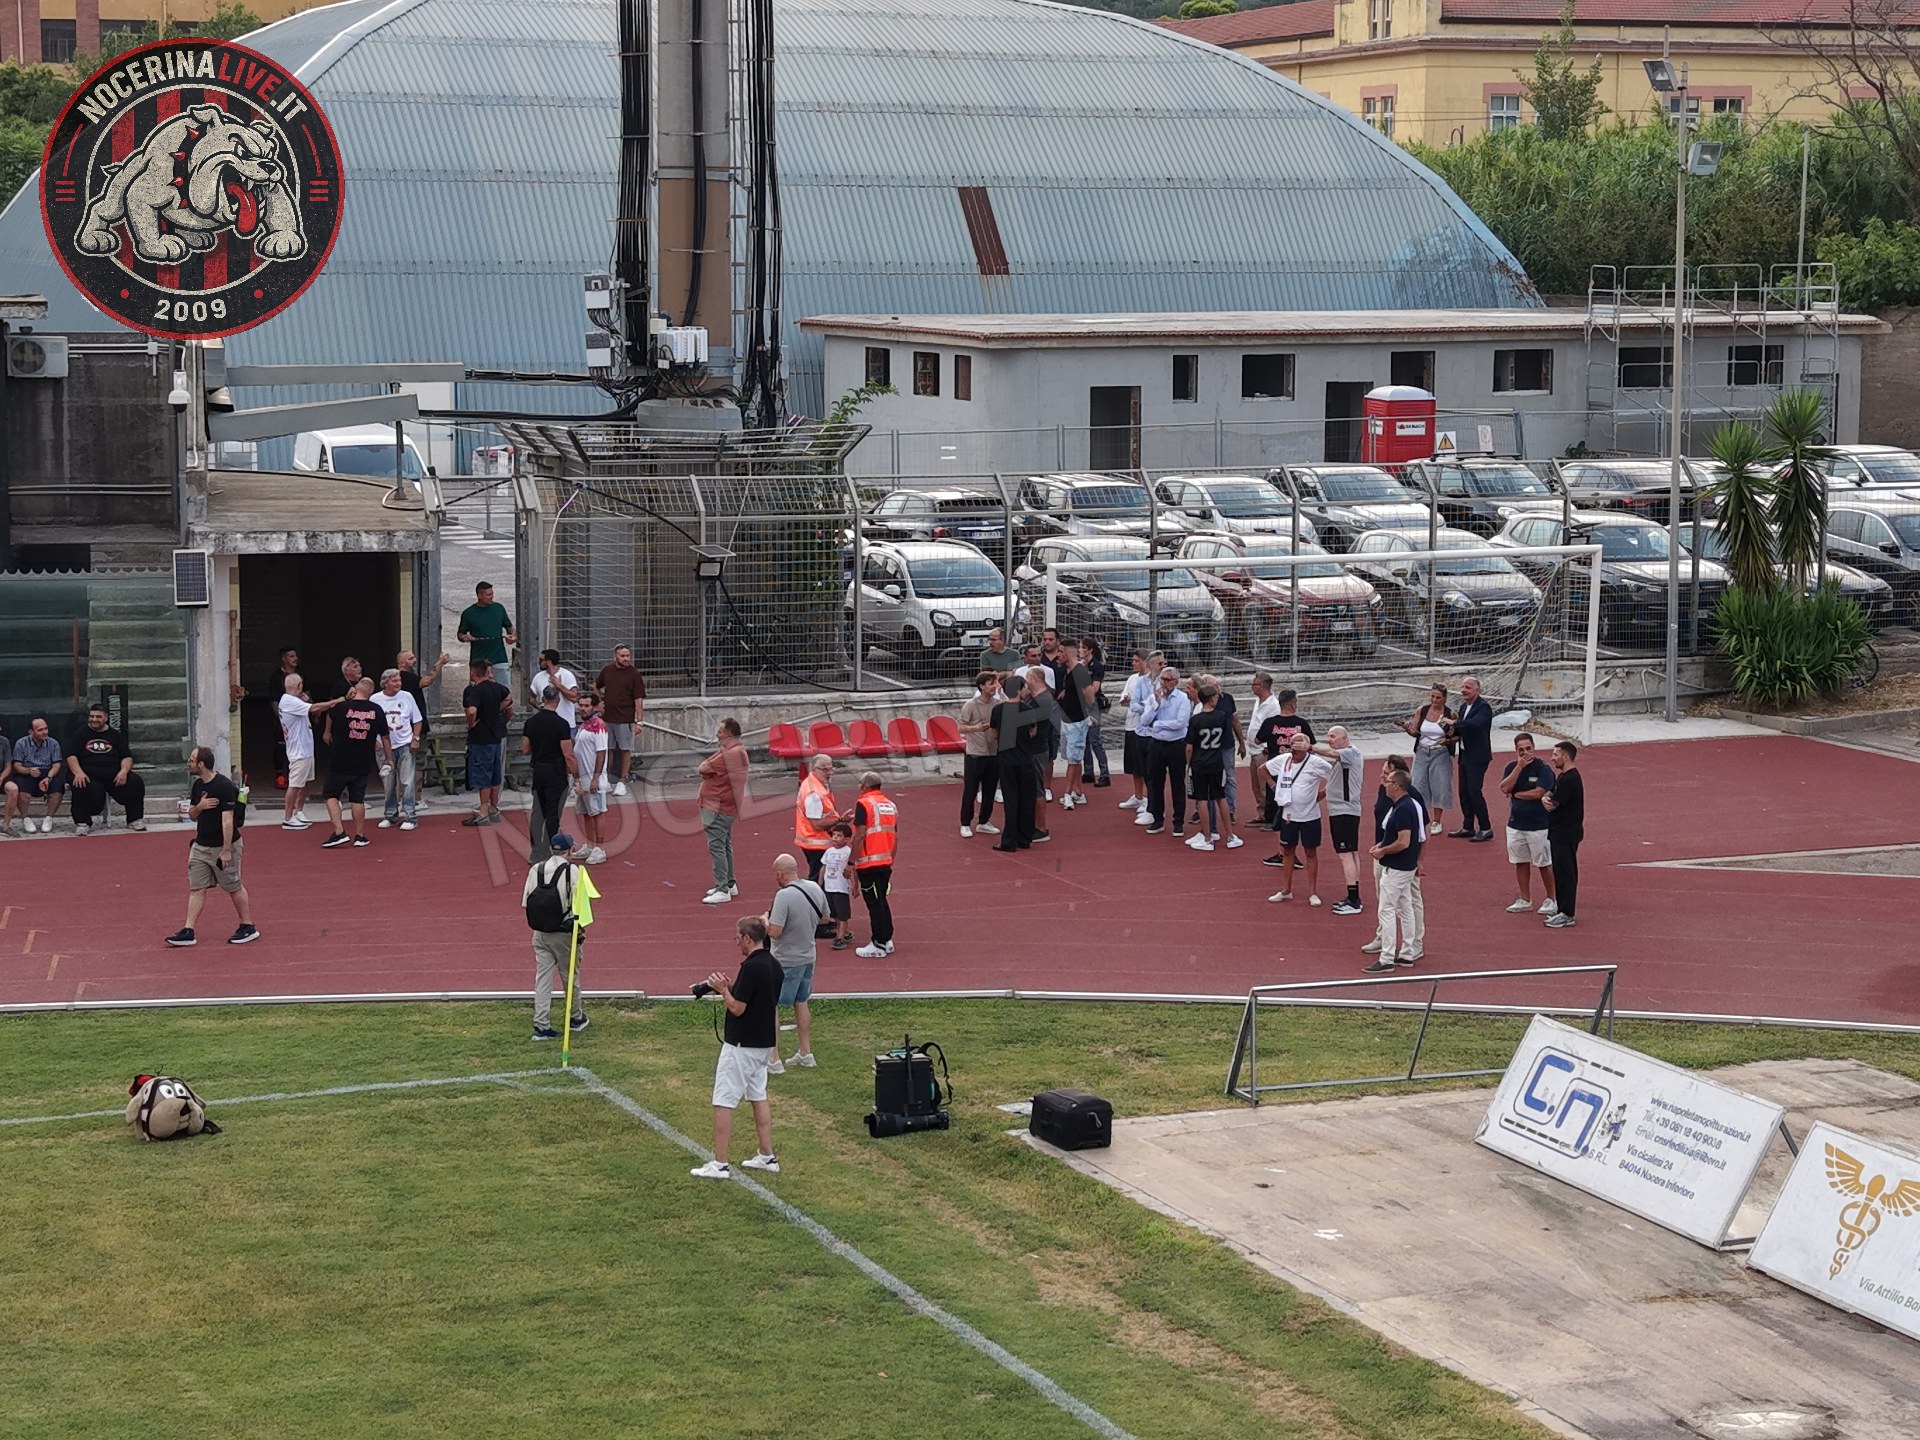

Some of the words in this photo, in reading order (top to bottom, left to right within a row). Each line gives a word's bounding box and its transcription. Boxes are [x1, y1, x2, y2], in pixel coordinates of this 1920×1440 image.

[1199, 727, 1223, 750] 22
[1656, 1117, 1670, 1129] +39
[1692, 1130, 1703, 1142] 40
[1626, 1144, 1638, 1156] Via
[1663, 1160, 1674, 1171] 24
[1618, 1159, 1641, 1175] 84014
[1640, 1167, 1666, 1187] Nocera
[1859, 1277, 1875, 1292] Via
[1873, 1284, 1905, 1305] Attilio
